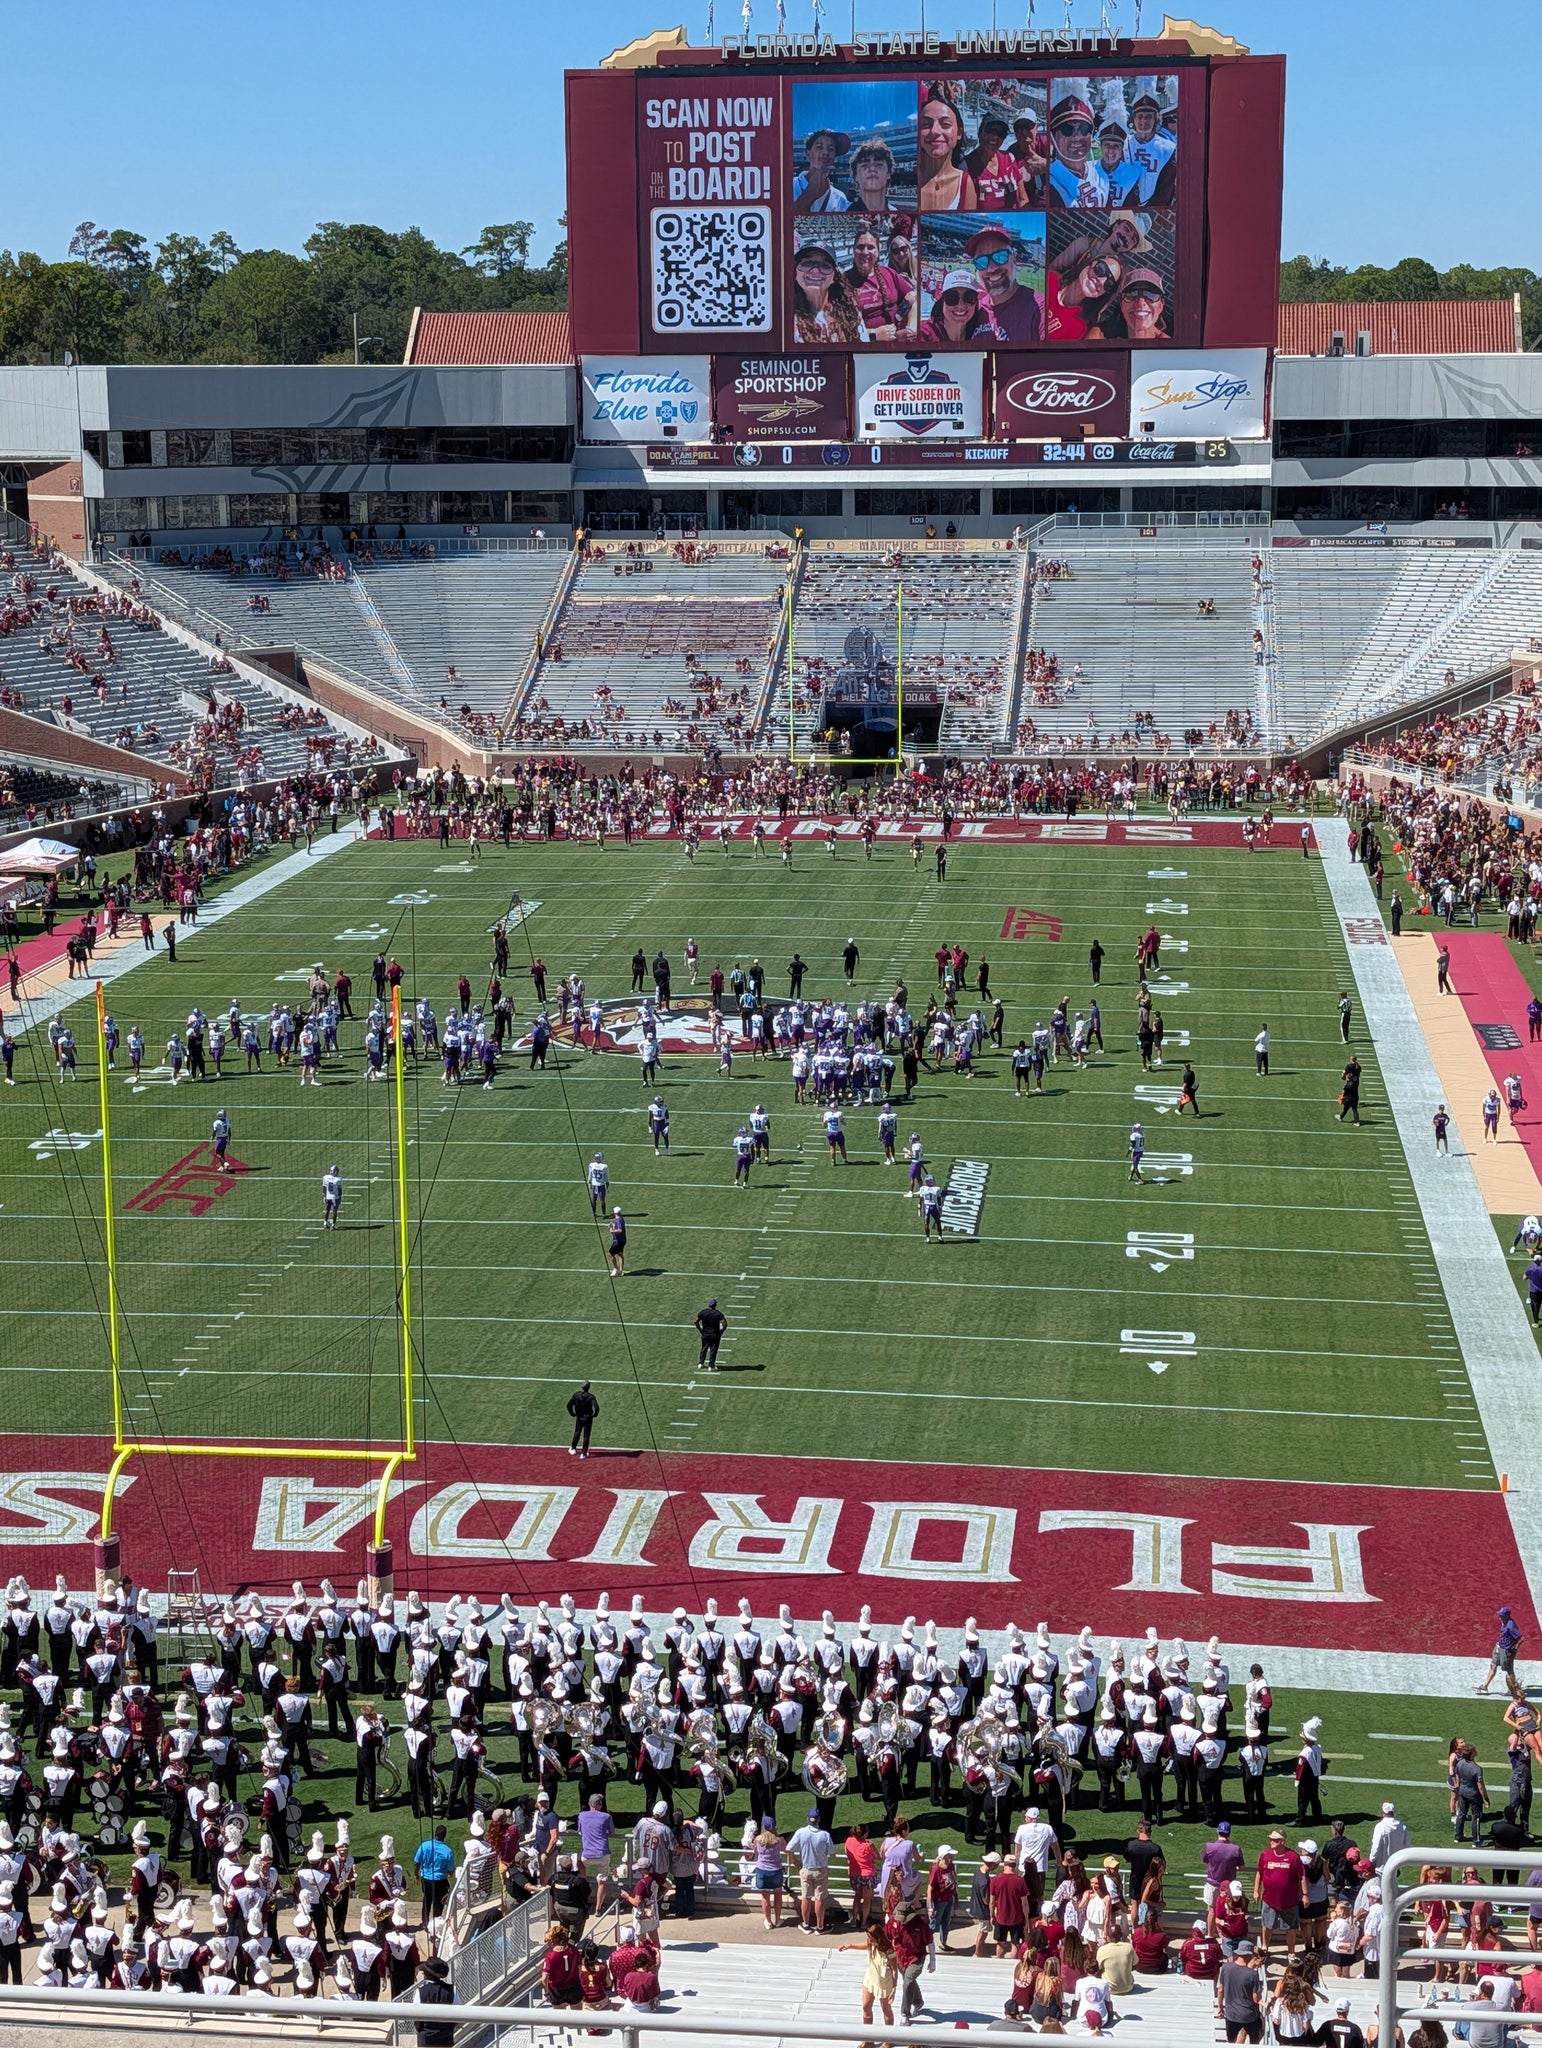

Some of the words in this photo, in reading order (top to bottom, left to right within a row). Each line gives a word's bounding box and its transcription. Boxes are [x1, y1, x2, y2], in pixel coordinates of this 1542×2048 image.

[721, 34, 837, 59] FLORIDA
[853, 30, 941, 56] STATE
[955, 26, 1123, 54] UNIVERSITY
[646, 98, 710, 128] SCAN
[717, 97, 773, 127] NOW
[664, 141, 684, 163] TO
[689, 131, 756, 163] POST
[651, 171, 664, 185] ON
[669, 166, 771, 200] BOARD!
[649, 185, 666, 199] THE
[741, 360, 820, 376] SEMINOLE
[594, 370, 694, 393] Florida
[734, 376, 827, 394] SPORTSHOP
[876, 389, 907, 401] DRIVE
[909, 388, 944, 401] SOBER
[946, 388, 961, 400] OR
[1025, 378, 1098, 409] Ford
[1140, 378, 1196, 411] Sun
[1183, 374, 1247, 410] Stop
[592, 397, 648, 421] Blue
[874, 404, 893, 417] GET
[896, 403, 934, 416] PULLED
[936, 402, 963, 415] OVER
[747, 426, 817, 436] SHOPFSU.COM
[650, 452, 672, 460] DOAK
[674, 451, 720, 460] CAMPBELL
[782, 446, 793, 464] 0
[871, 446, 882, 464] 0
[964, 448, 1009, 460] KICKOFF
[1043, 444, 1086, 461] 32:44
[1095, 446, 1113, 459] CC
[1208, 443, 1227, 457] 25
[1142, 528, 1154, 536] 101
[905, 693, 932, 702] DOAK
[940, 1158, 990, 1236] PROGRESSIVE
[1125, 1231, 1195, 1260] 20
[1119, 1329, 1198, 1356] 10
[252, 1476, 1384, 1604] FLORIDA
[643, 1833, 659, 1851] 28
[562, 1954, 569, 1972] 1
